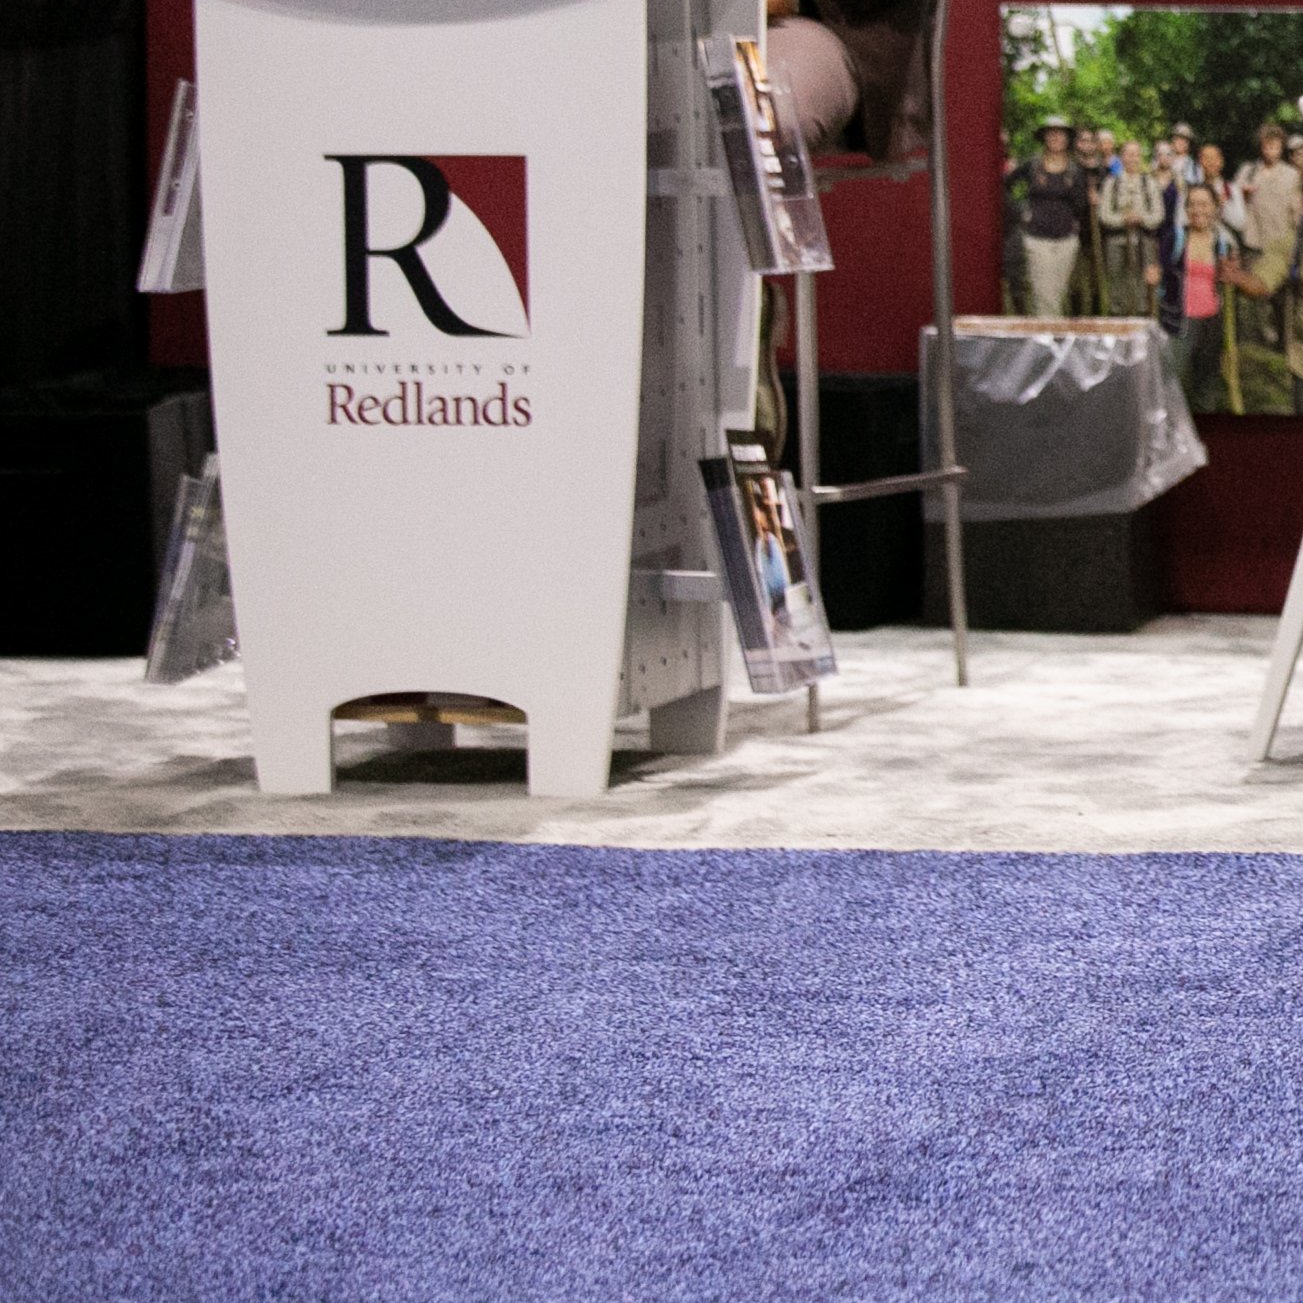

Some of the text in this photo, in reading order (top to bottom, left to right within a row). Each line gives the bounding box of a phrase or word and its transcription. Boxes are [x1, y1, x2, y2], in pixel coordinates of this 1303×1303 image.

[325, 363, 532, 377] UNIVERSITY OF
[326, 381, 533, 428] Redlands
